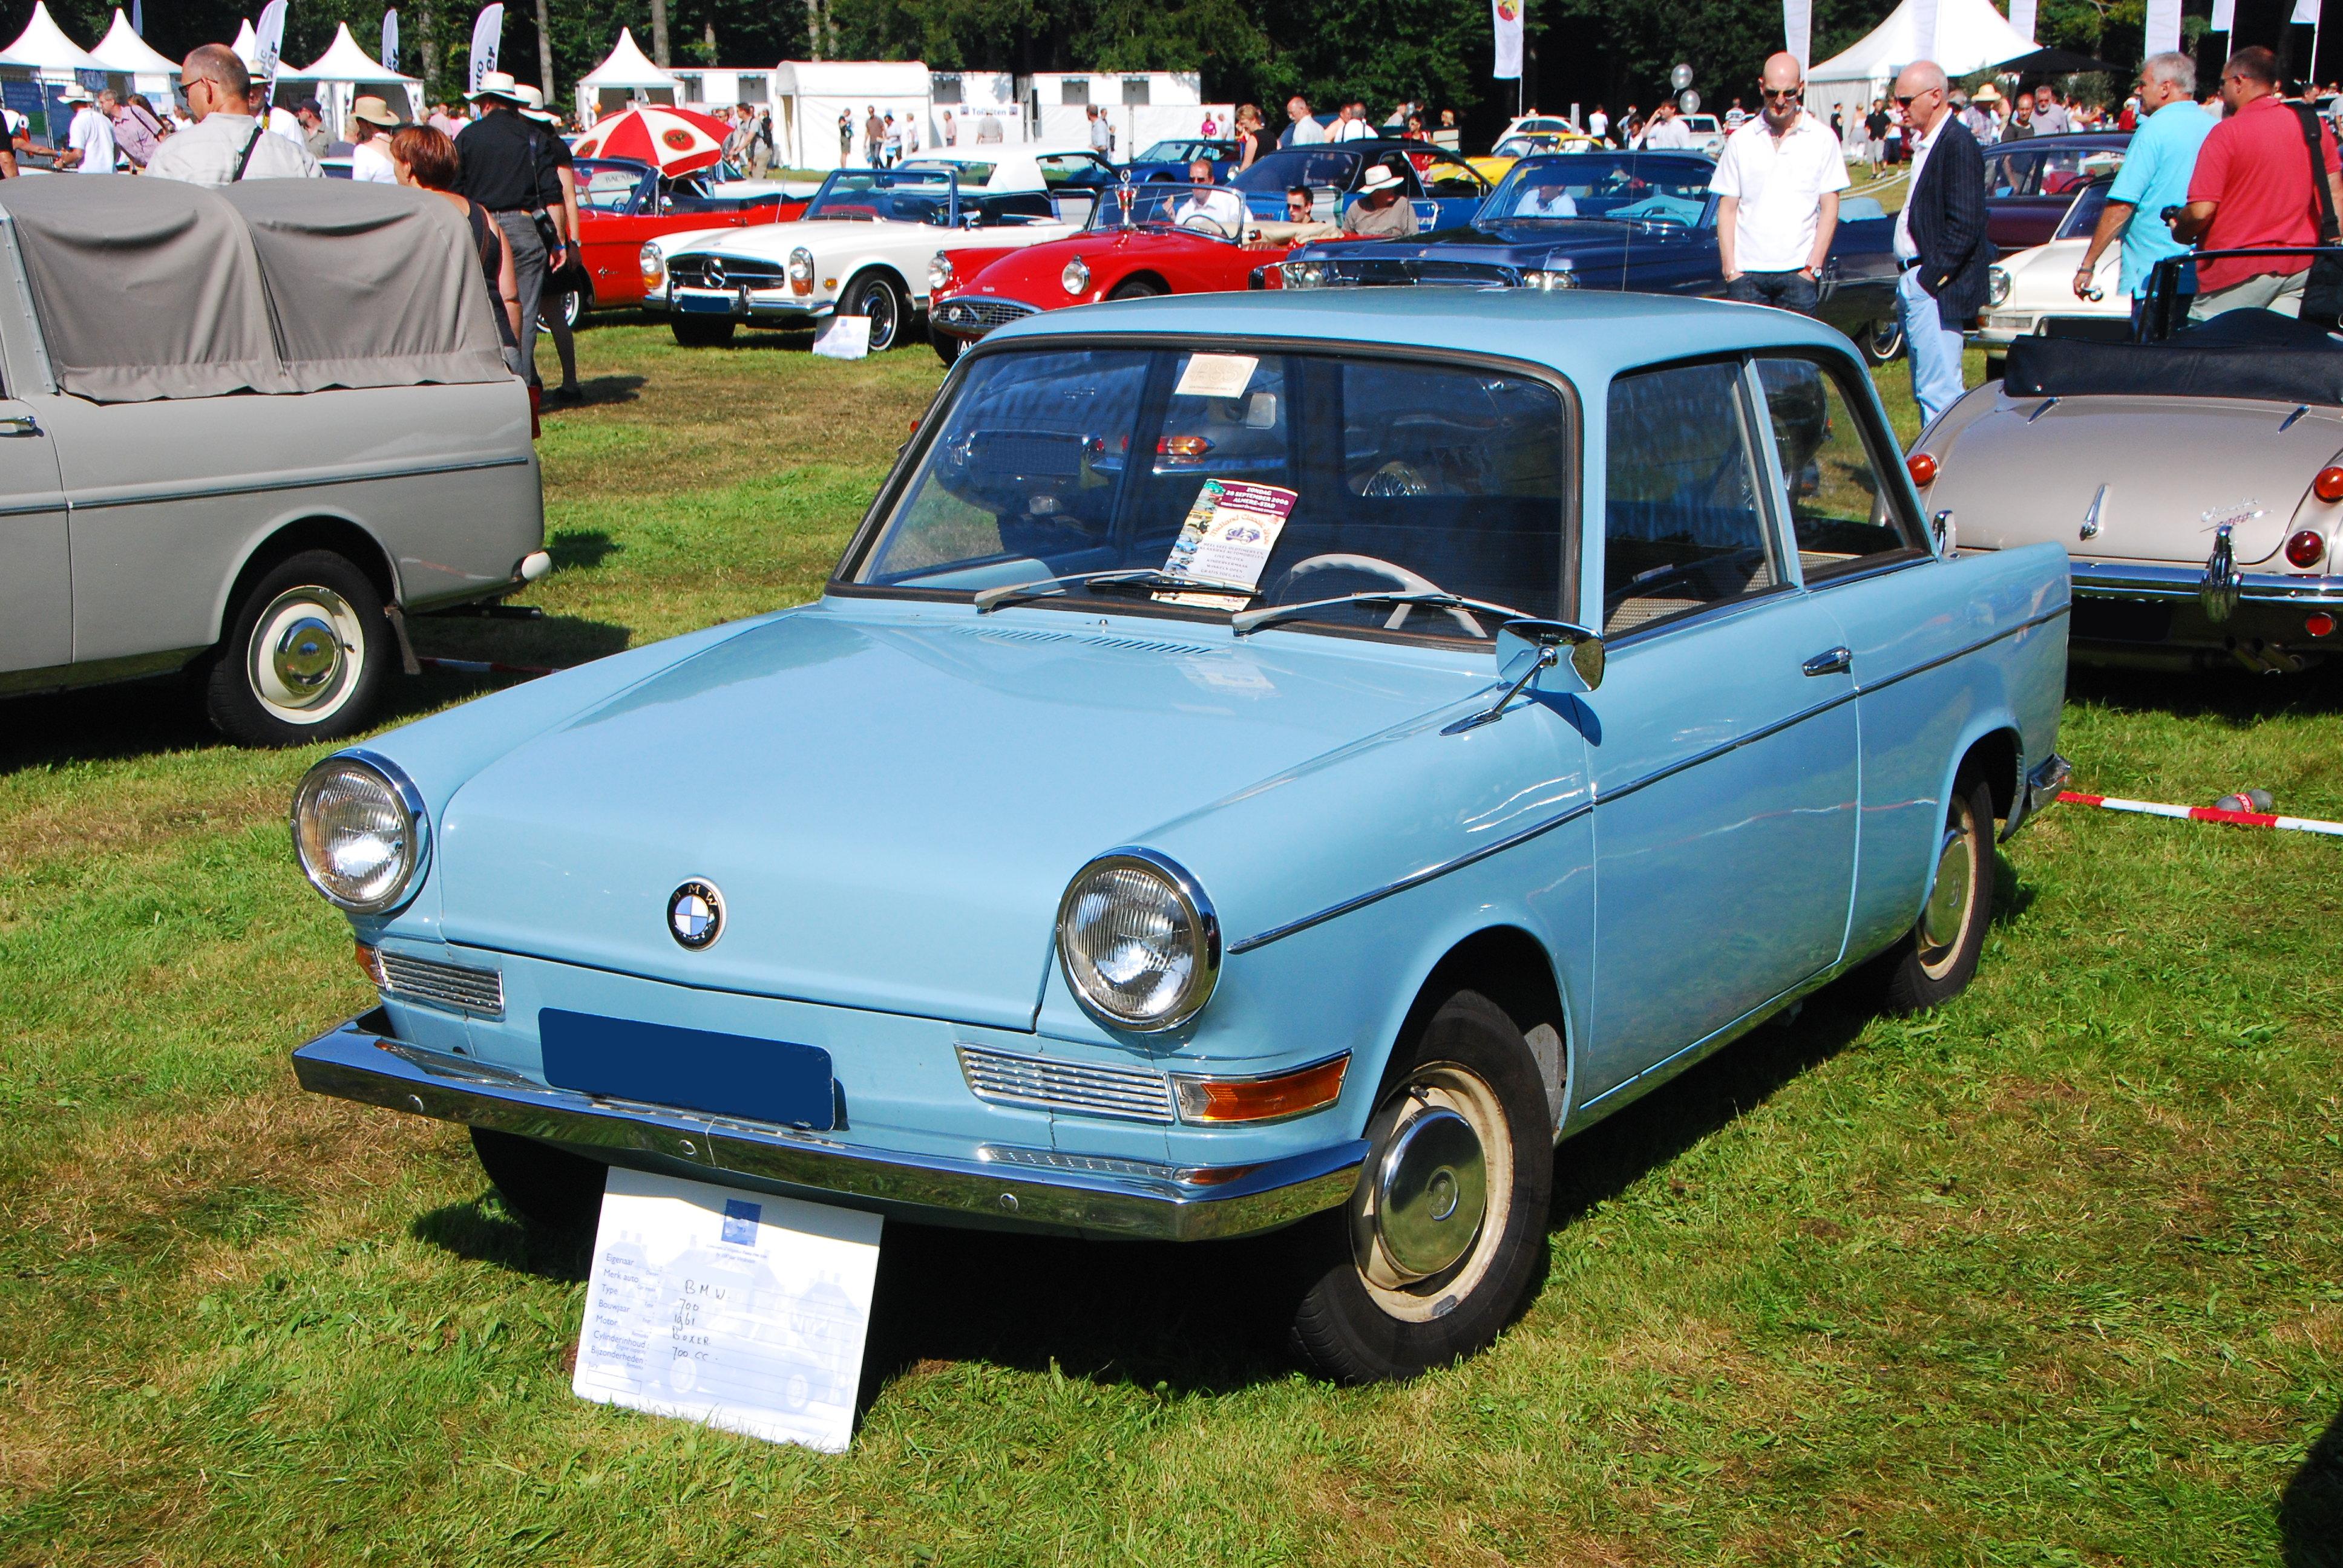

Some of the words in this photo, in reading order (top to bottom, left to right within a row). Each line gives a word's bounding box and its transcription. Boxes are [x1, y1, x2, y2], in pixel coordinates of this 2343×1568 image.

[1234, 491, 1272, 501] SEPTEMBER
[1247, 487, 1272, 496] ZONDAG
[606, 1253, 635, 1266] Eigenaar
[603, 1269, 621, 1279] Merk
[623, 1274, 640, 1283] auto
[601, 1283, 618, 1296] Type
[598, 1299, 631, 1313] Bouwjaar
[679, 1298, 699, 1315] 700
[596, 1315, 618, 1326] Motor
[593, 1330, 646, 1349] Cylinderinhoud
[591, 1345, 644, 1365] Bijzonderheden
[672, 1346, 689, 1361] 700
